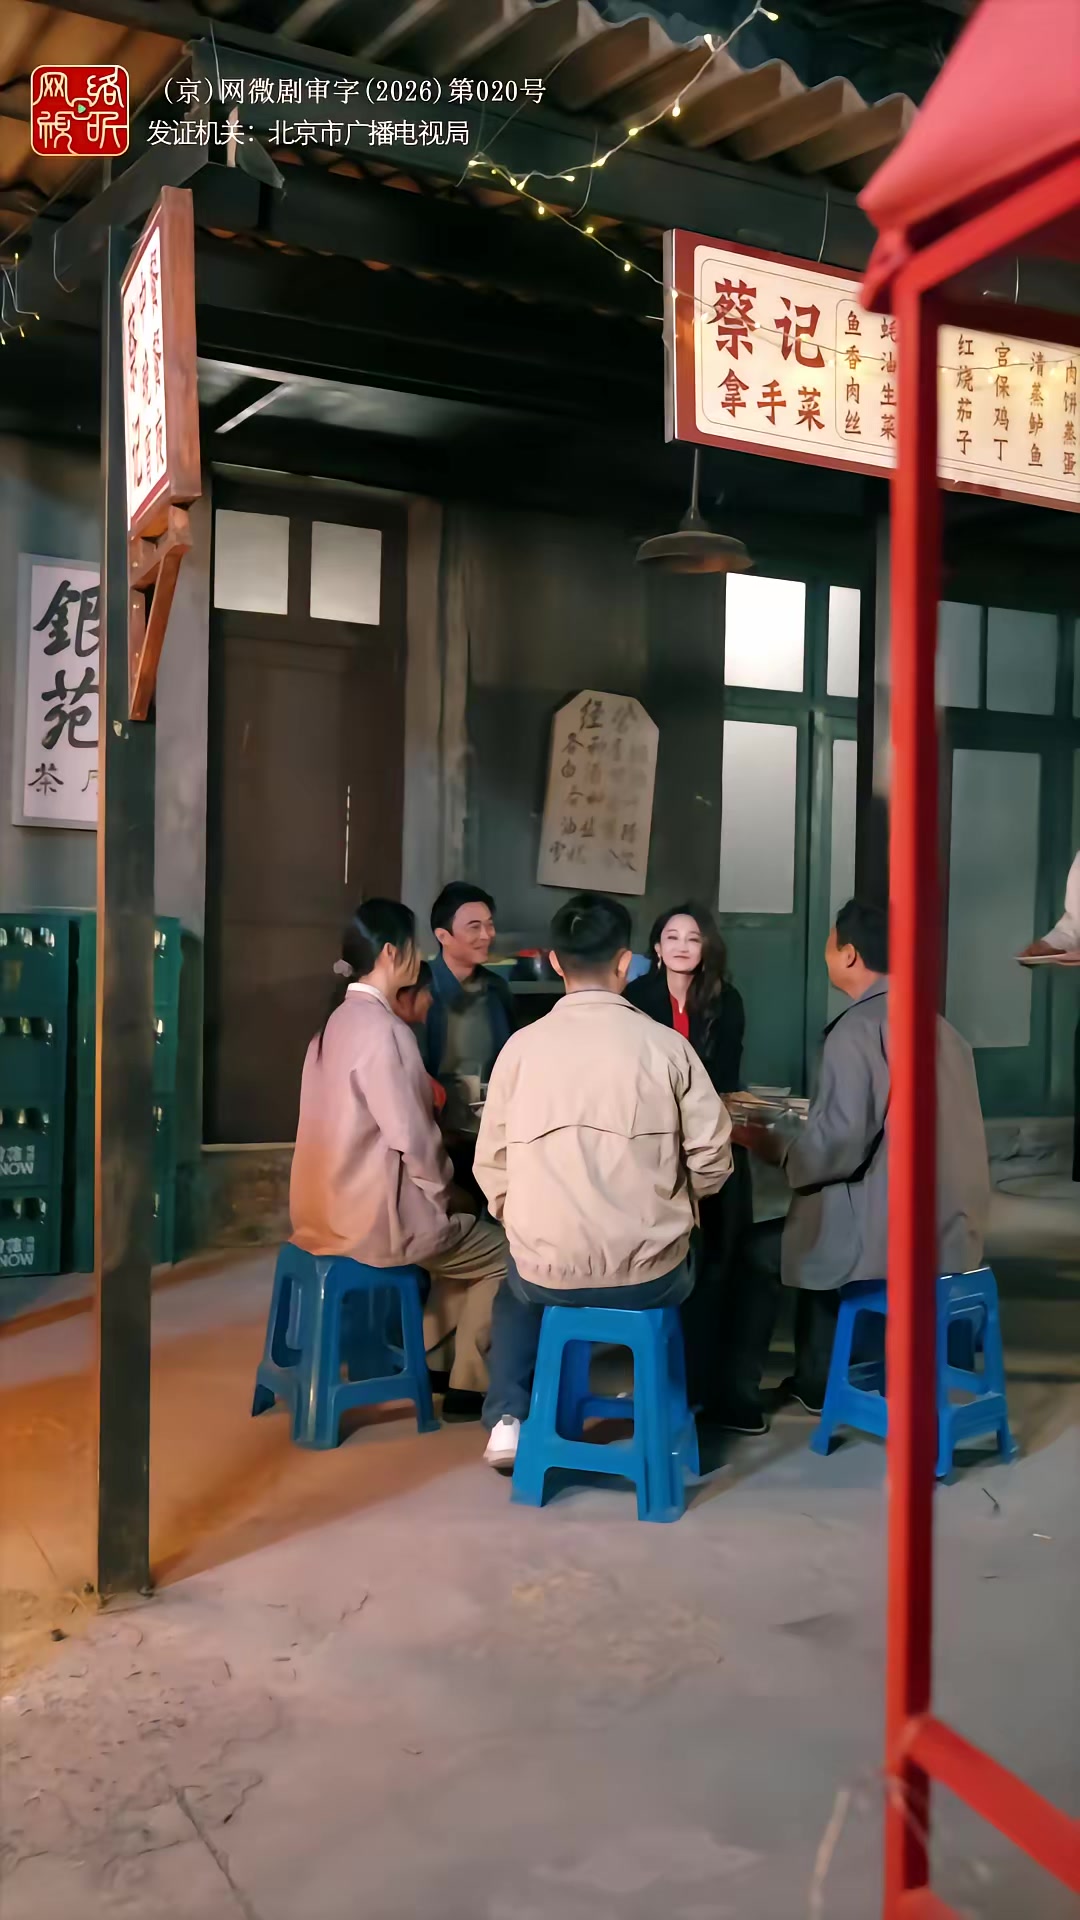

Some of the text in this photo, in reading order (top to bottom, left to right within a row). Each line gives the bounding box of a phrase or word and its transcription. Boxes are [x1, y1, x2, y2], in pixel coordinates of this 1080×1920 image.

[706, 277, 826, 368] 蔡记
[843, 310, 862, 434] 鱼香肉丝
[879, 317, 898, 441] 蚝油生菜
[717, 367, 826, 432] 拿手菜
[955, 333, 974, 456] 红烧茄子
[993, 341, 1011, 462] 宫保鸡丁
[1027, 351, 1044, 467] 清蒸鲈鱼
[1062, 359, 1078, 476] 肉饼蒸蛋
